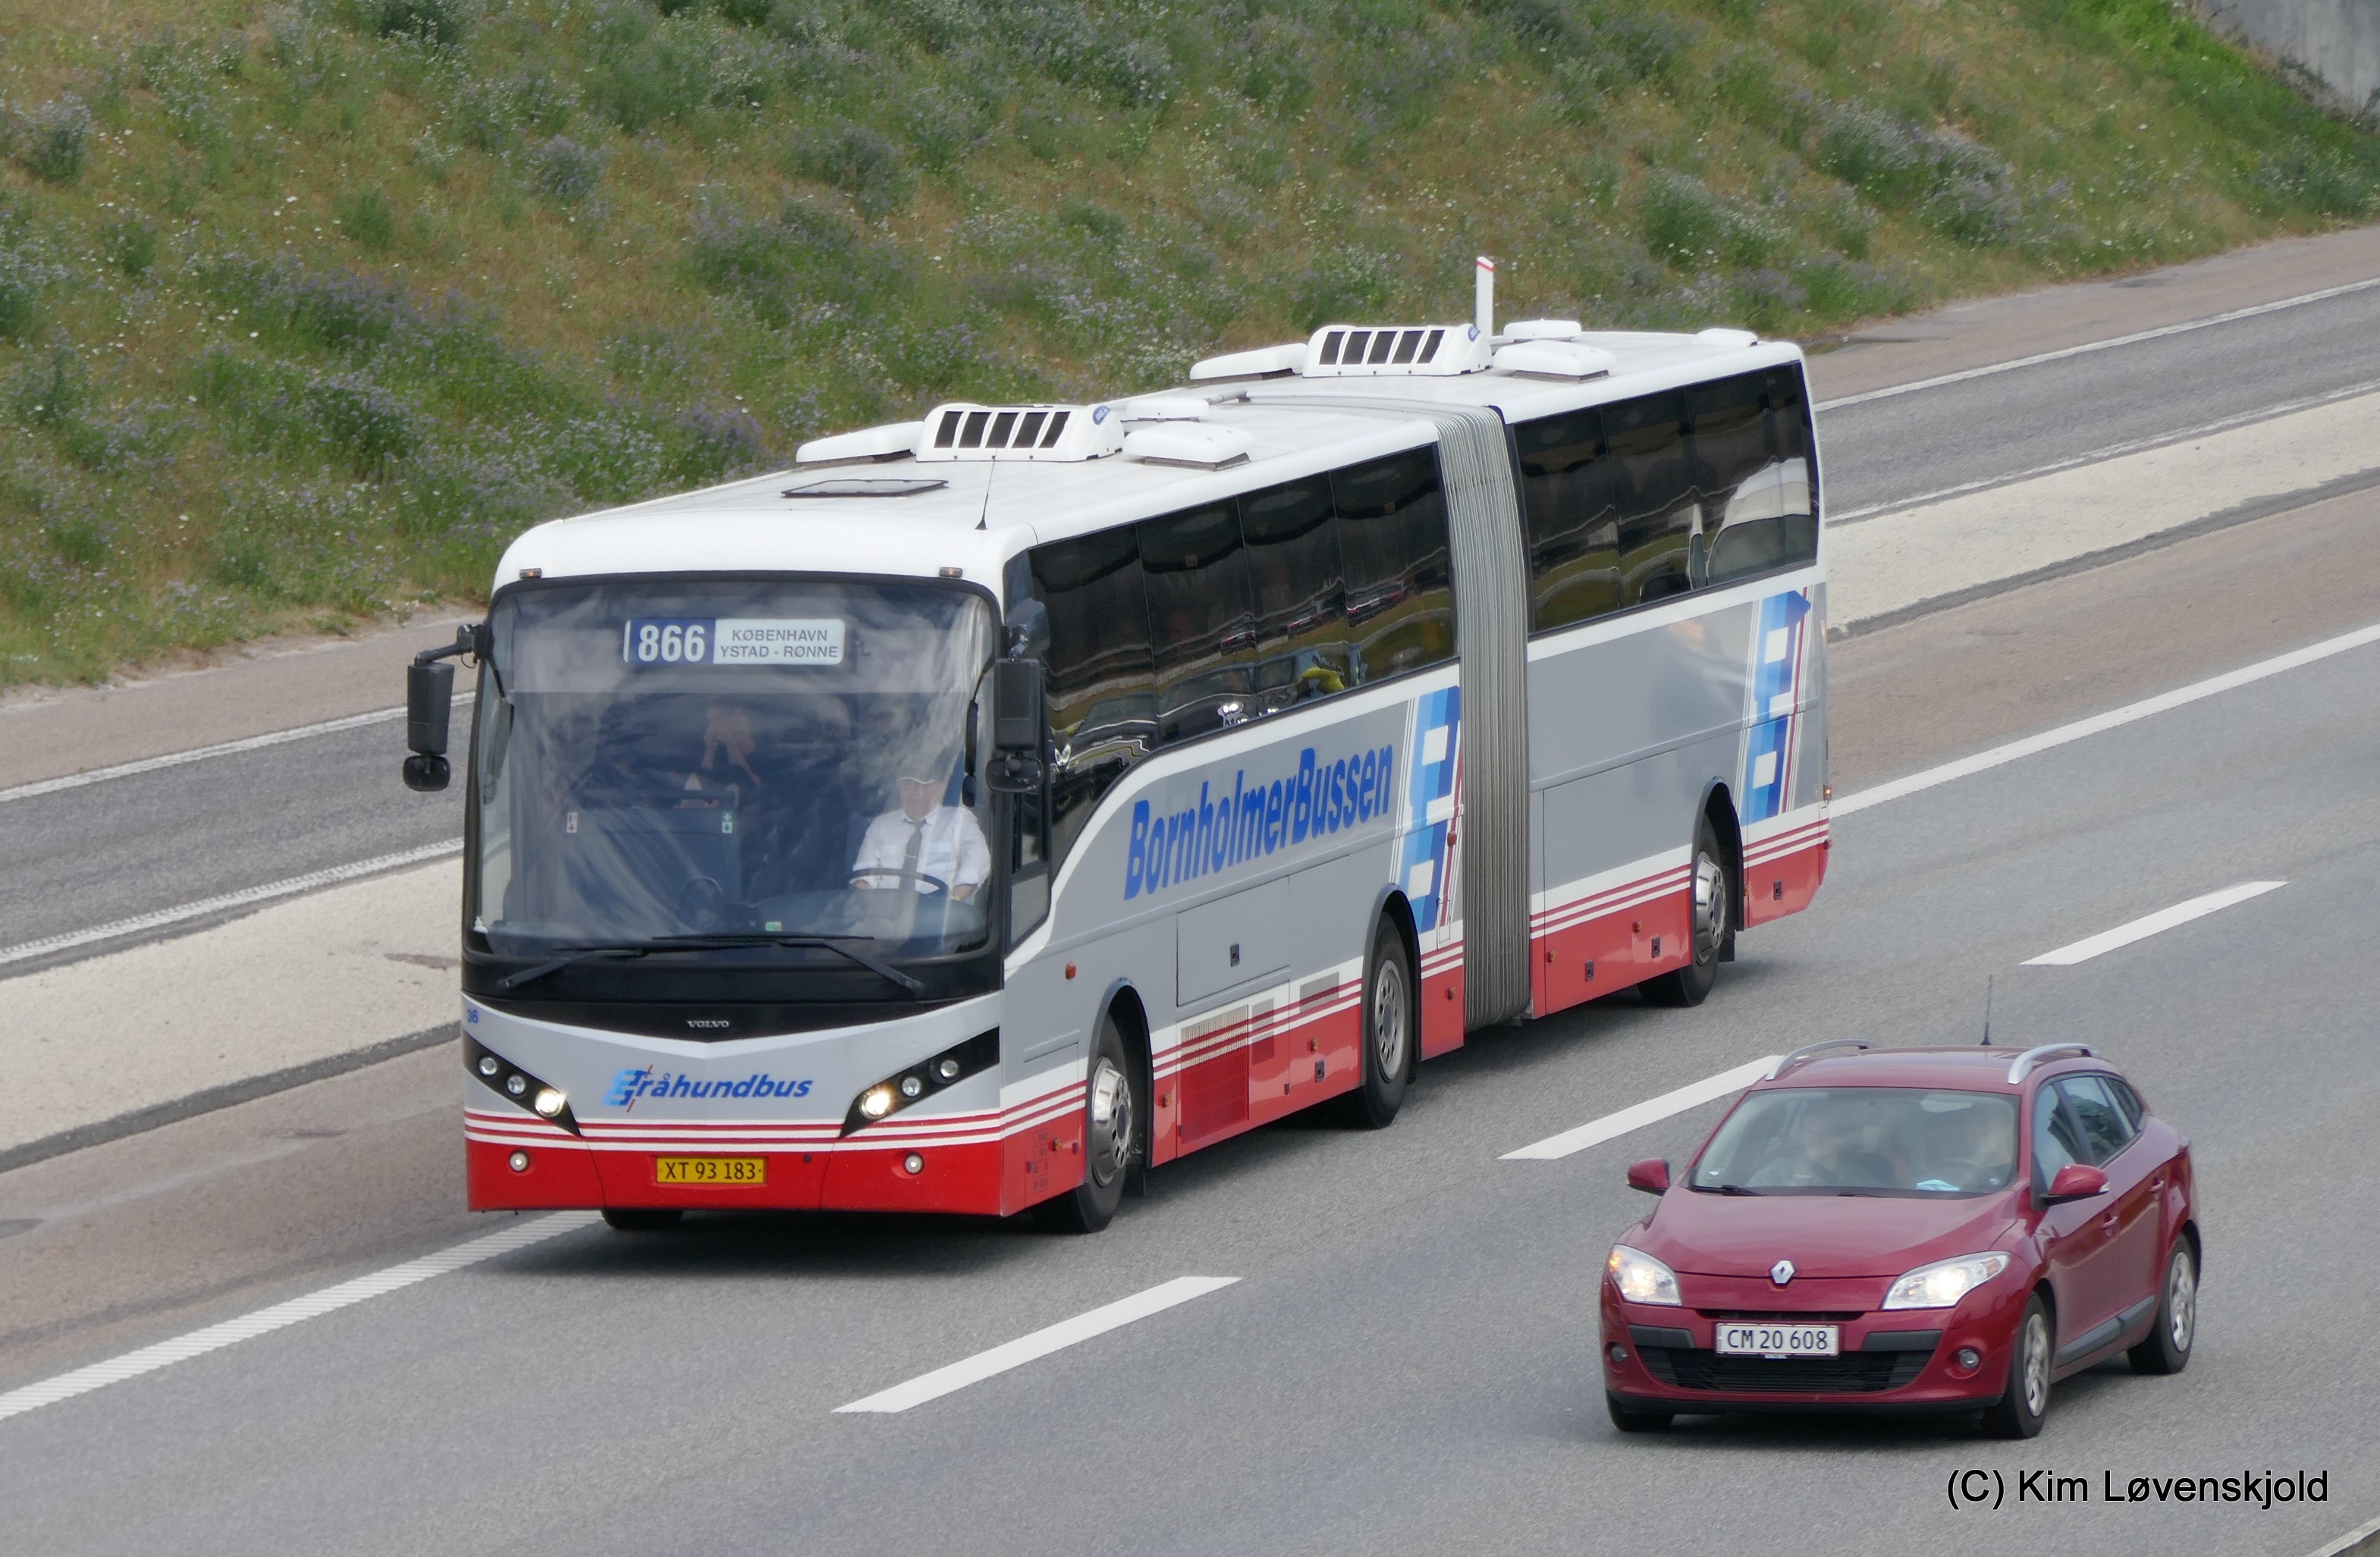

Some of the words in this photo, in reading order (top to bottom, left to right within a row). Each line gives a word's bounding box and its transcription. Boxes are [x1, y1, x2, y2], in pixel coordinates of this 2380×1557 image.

[638, 624, 705, 663] 866
[731, 629, 828, 642] KØBENHAVN
[721, 645, 770, 658] YSTAD
[783, 645, 838, 658] RØNNE
[1124, 743, 1393, 901] BornholmerBussen
[686, 1020, 730, 1028] VOLVO
[665, 1162, 689, 1179] XT
[695, 1162, 717, 1179] 93
[724, 1162, 756, 1180] 183
[1727, 1329, 1754, 1348] CM
[1760, 1330, 1784, 1349] 20
[1790, 1330, 1828, 1350] 608
